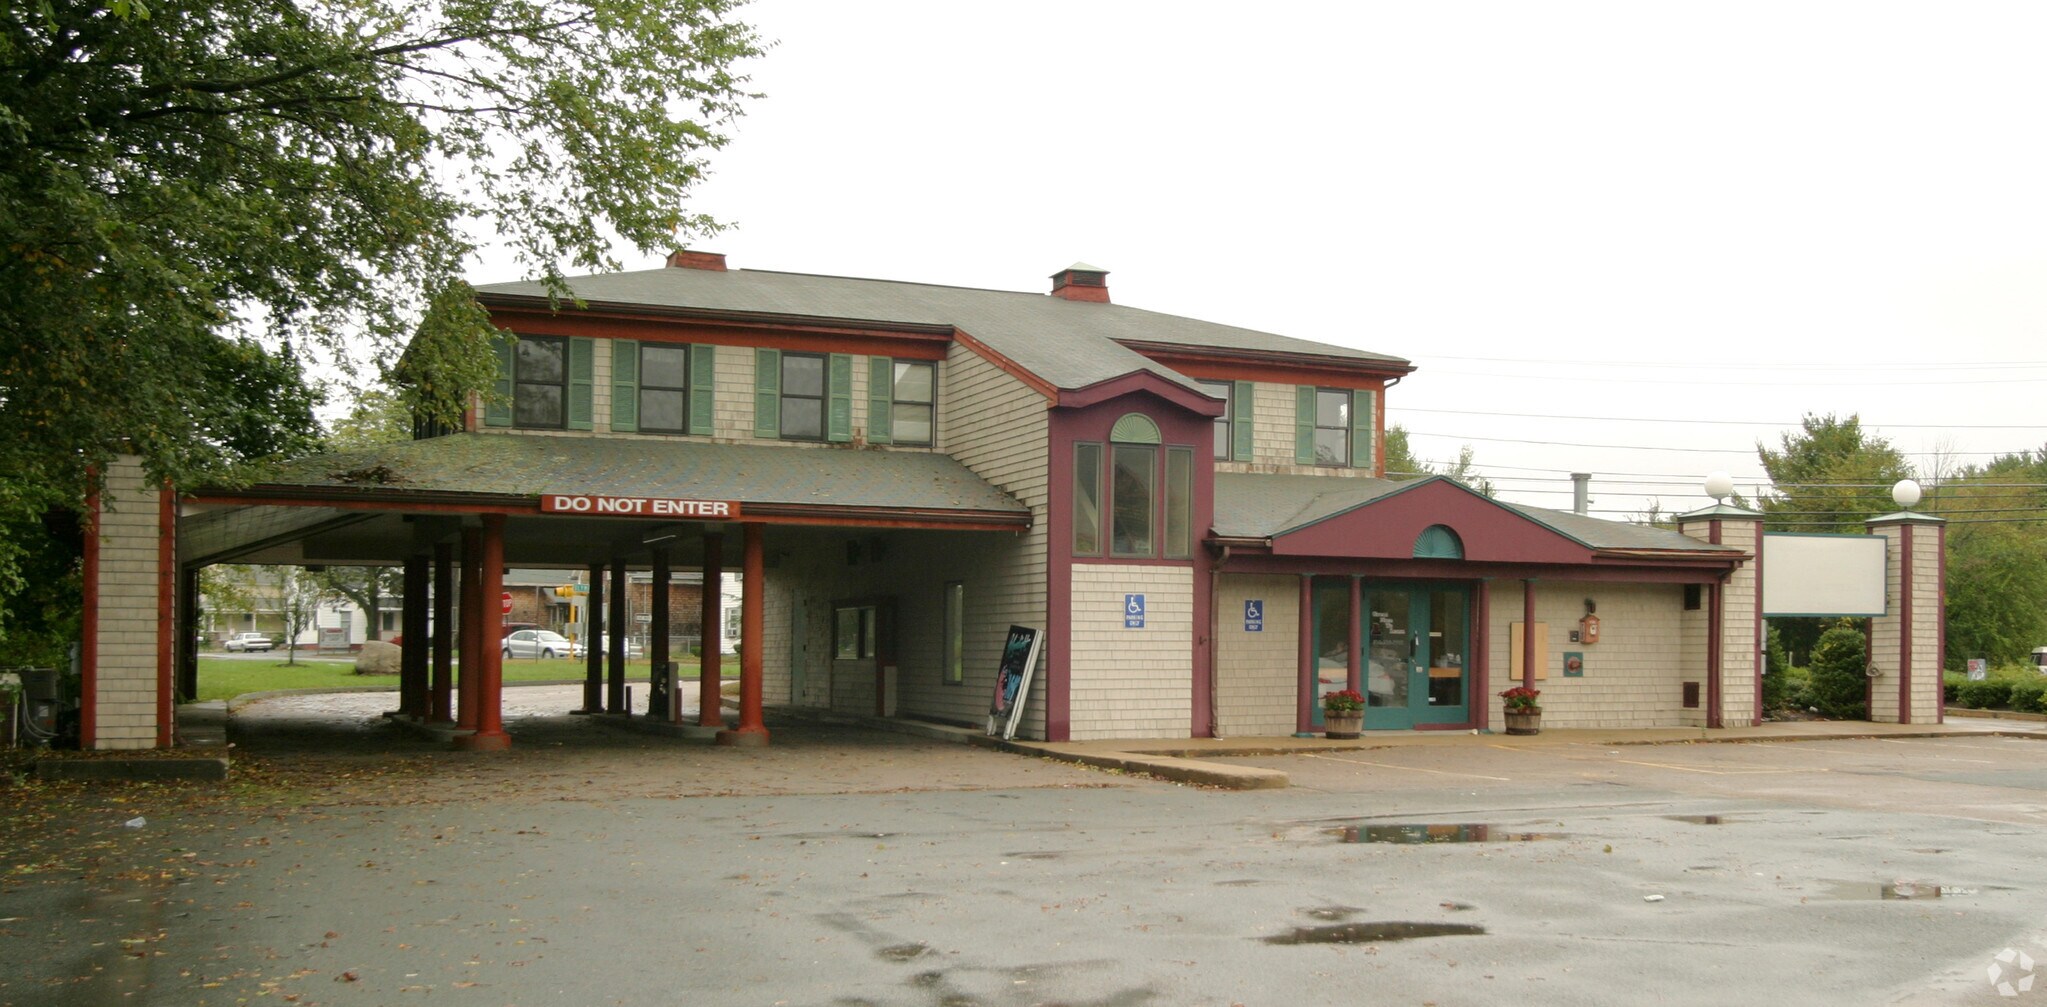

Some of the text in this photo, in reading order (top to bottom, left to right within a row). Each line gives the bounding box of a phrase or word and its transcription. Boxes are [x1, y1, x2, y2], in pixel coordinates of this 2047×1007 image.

[554, 496, 729, 515] DO NOT ENTER
[502, 599, 512, 607] TOP
